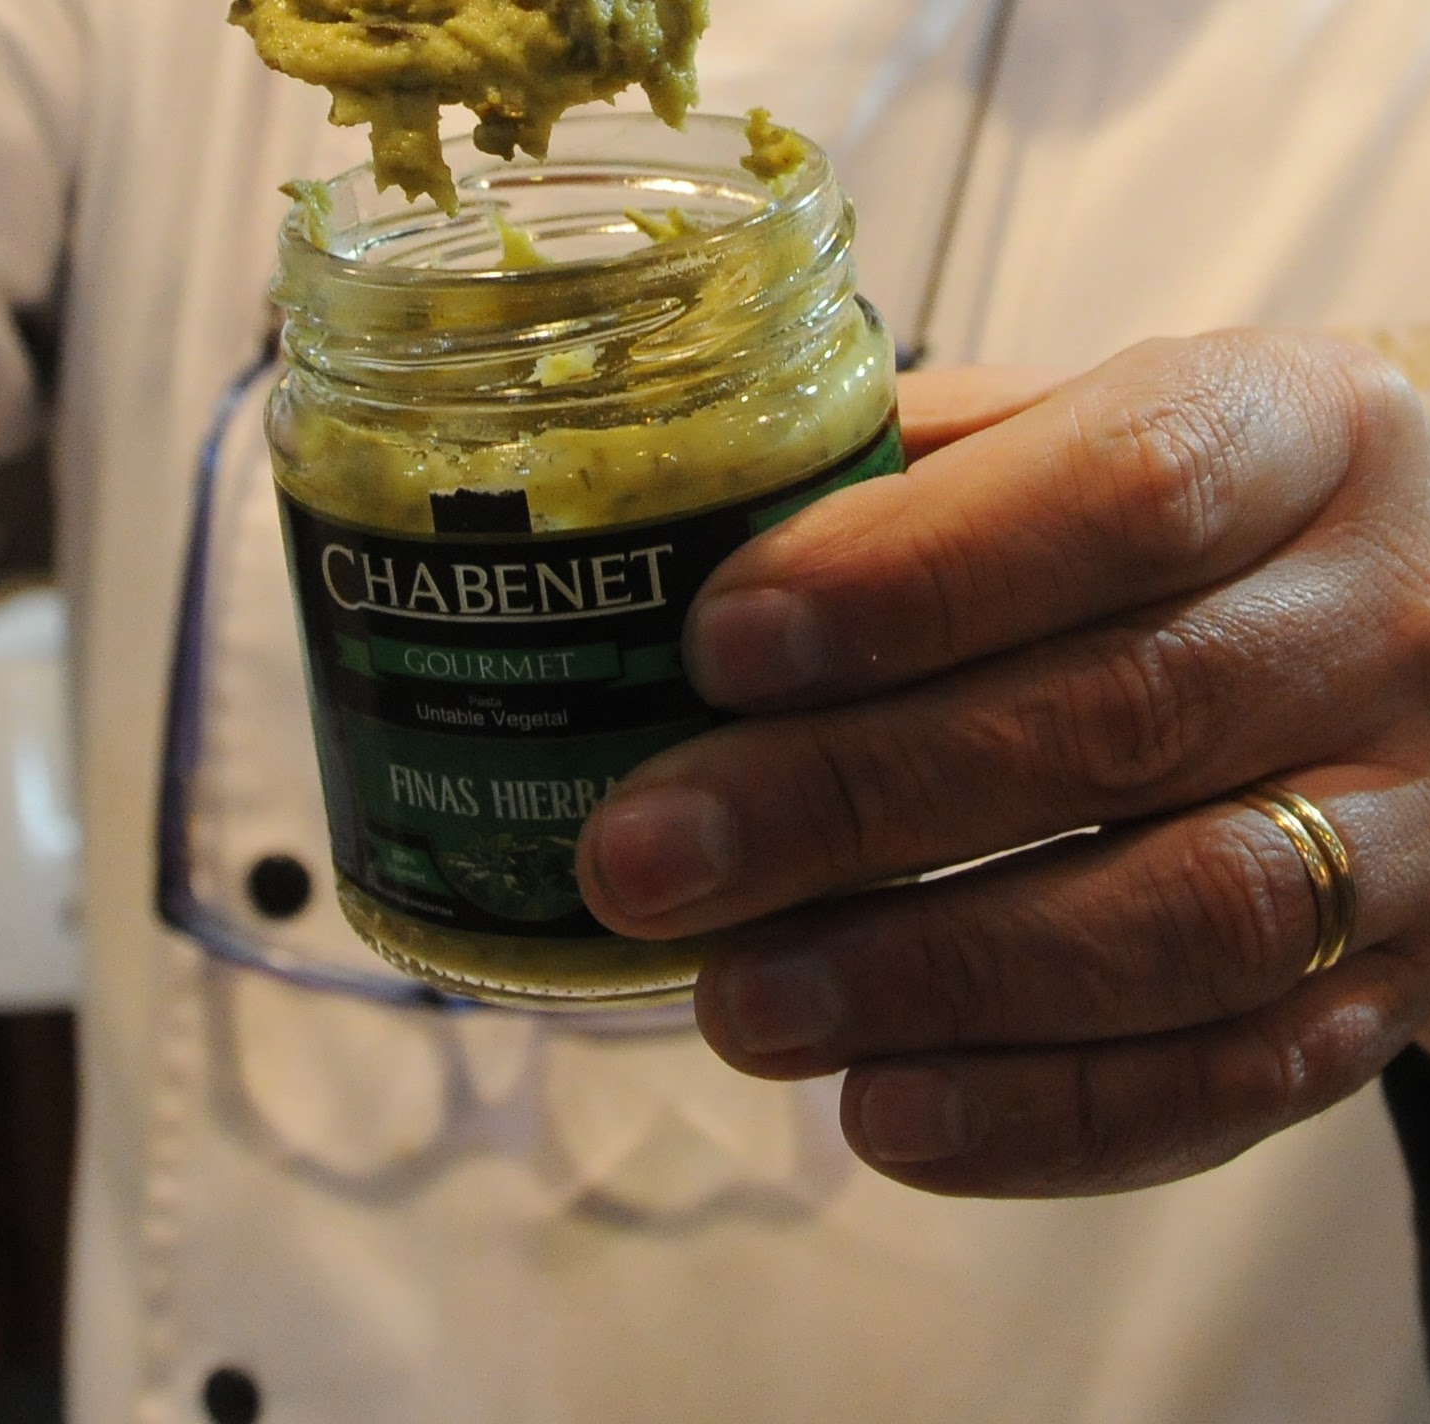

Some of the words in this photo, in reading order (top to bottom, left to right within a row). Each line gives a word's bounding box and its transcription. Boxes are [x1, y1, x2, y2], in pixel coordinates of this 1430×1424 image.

[321, 543, 674, 618] CHABENET
[404, 648, 574, 680] GOURMET
[416, 703, 485, 726] Untable
[491, 708, 569, 731] Vegetal
[389, 763, 480, 817] FINAS
